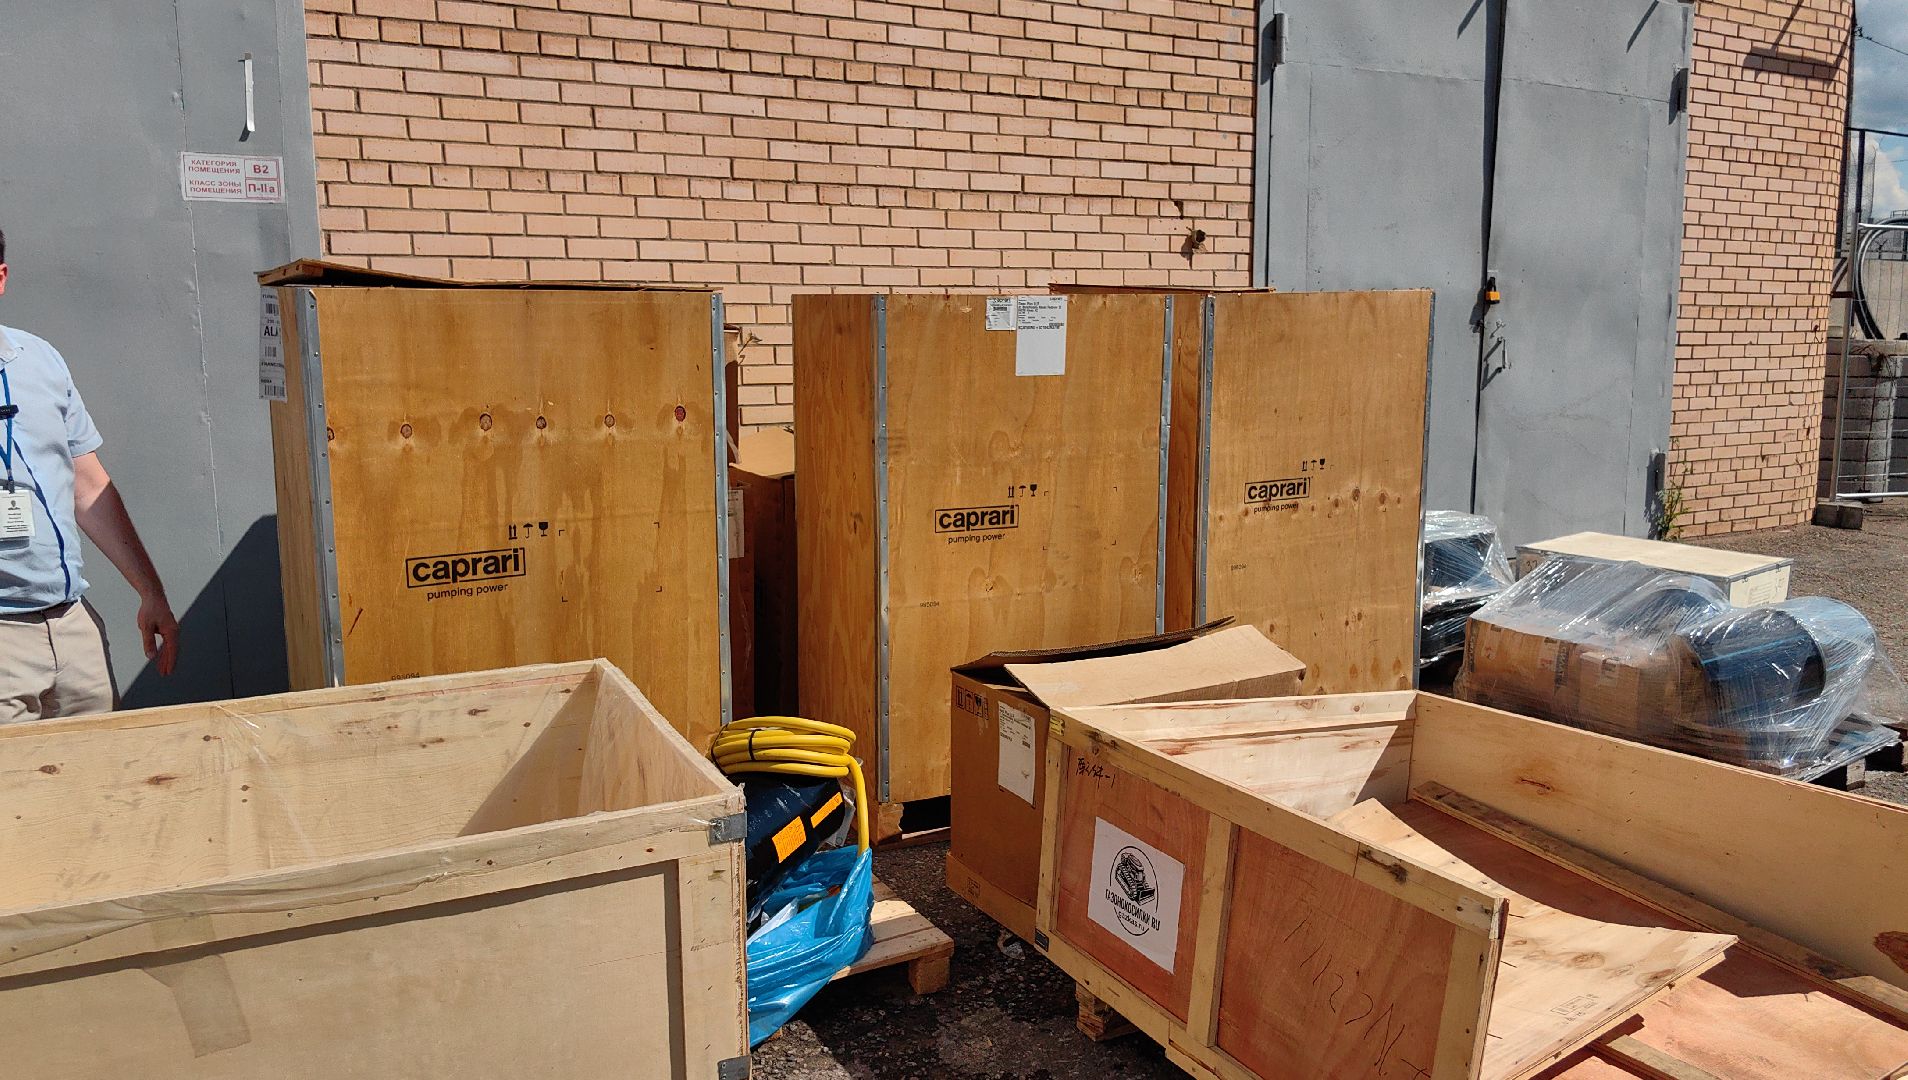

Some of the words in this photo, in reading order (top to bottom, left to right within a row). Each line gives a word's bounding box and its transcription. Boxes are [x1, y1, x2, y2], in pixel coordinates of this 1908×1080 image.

[191, 159, 237, 167] КАТЕГОРИЯ
[252, 164, 270, 174] В2
[188, 166, 241, 174] ПОМЕЩЕНИЯ
[190, 186, 242, 194] ПОМЕЩЕНИЯ
[218, 180, 242, 188] ЗОНЫ
[1247, 477, 1307, 502] caprari
[1253, 504, 1280, 514] pumping
[1280, 502, 1299, 511] power
[938, 504, 1015, 532] caprari
[948, 534, 981, 545] pumping
[982, 532, 1006, 543] power
[412, 547, 520, 584] caprari
[426, 586, 473, 601] pumping
[476, 583, 508, 597] power
[1105, 888, 1151, 926] ГАЗОНОКОСИЛКИ
[1151, 916, 1161, 932] RU
